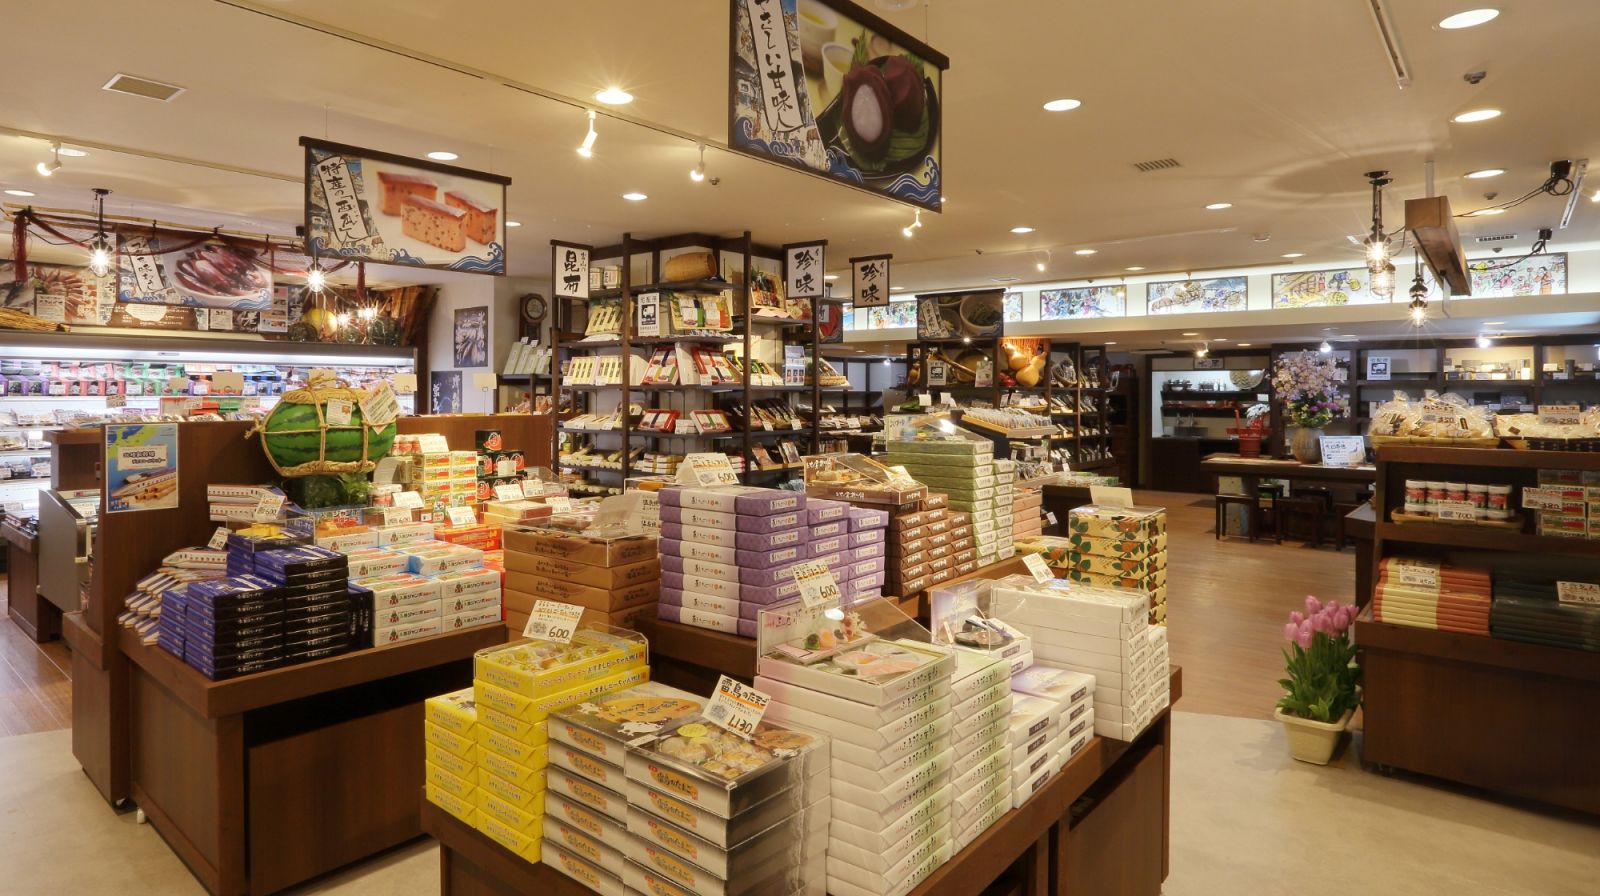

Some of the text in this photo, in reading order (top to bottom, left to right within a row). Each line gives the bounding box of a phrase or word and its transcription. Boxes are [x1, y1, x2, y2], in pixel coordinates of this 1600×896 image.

[563, 249, 580, 294] 昆布
[794, 249, 814, 293] 珍味
[861, 262, 880, 303] 珍味
[718, 472, 735, 483] 600
[820, 584, 837, 599] 600
[549, 625, 570, 639] 600
